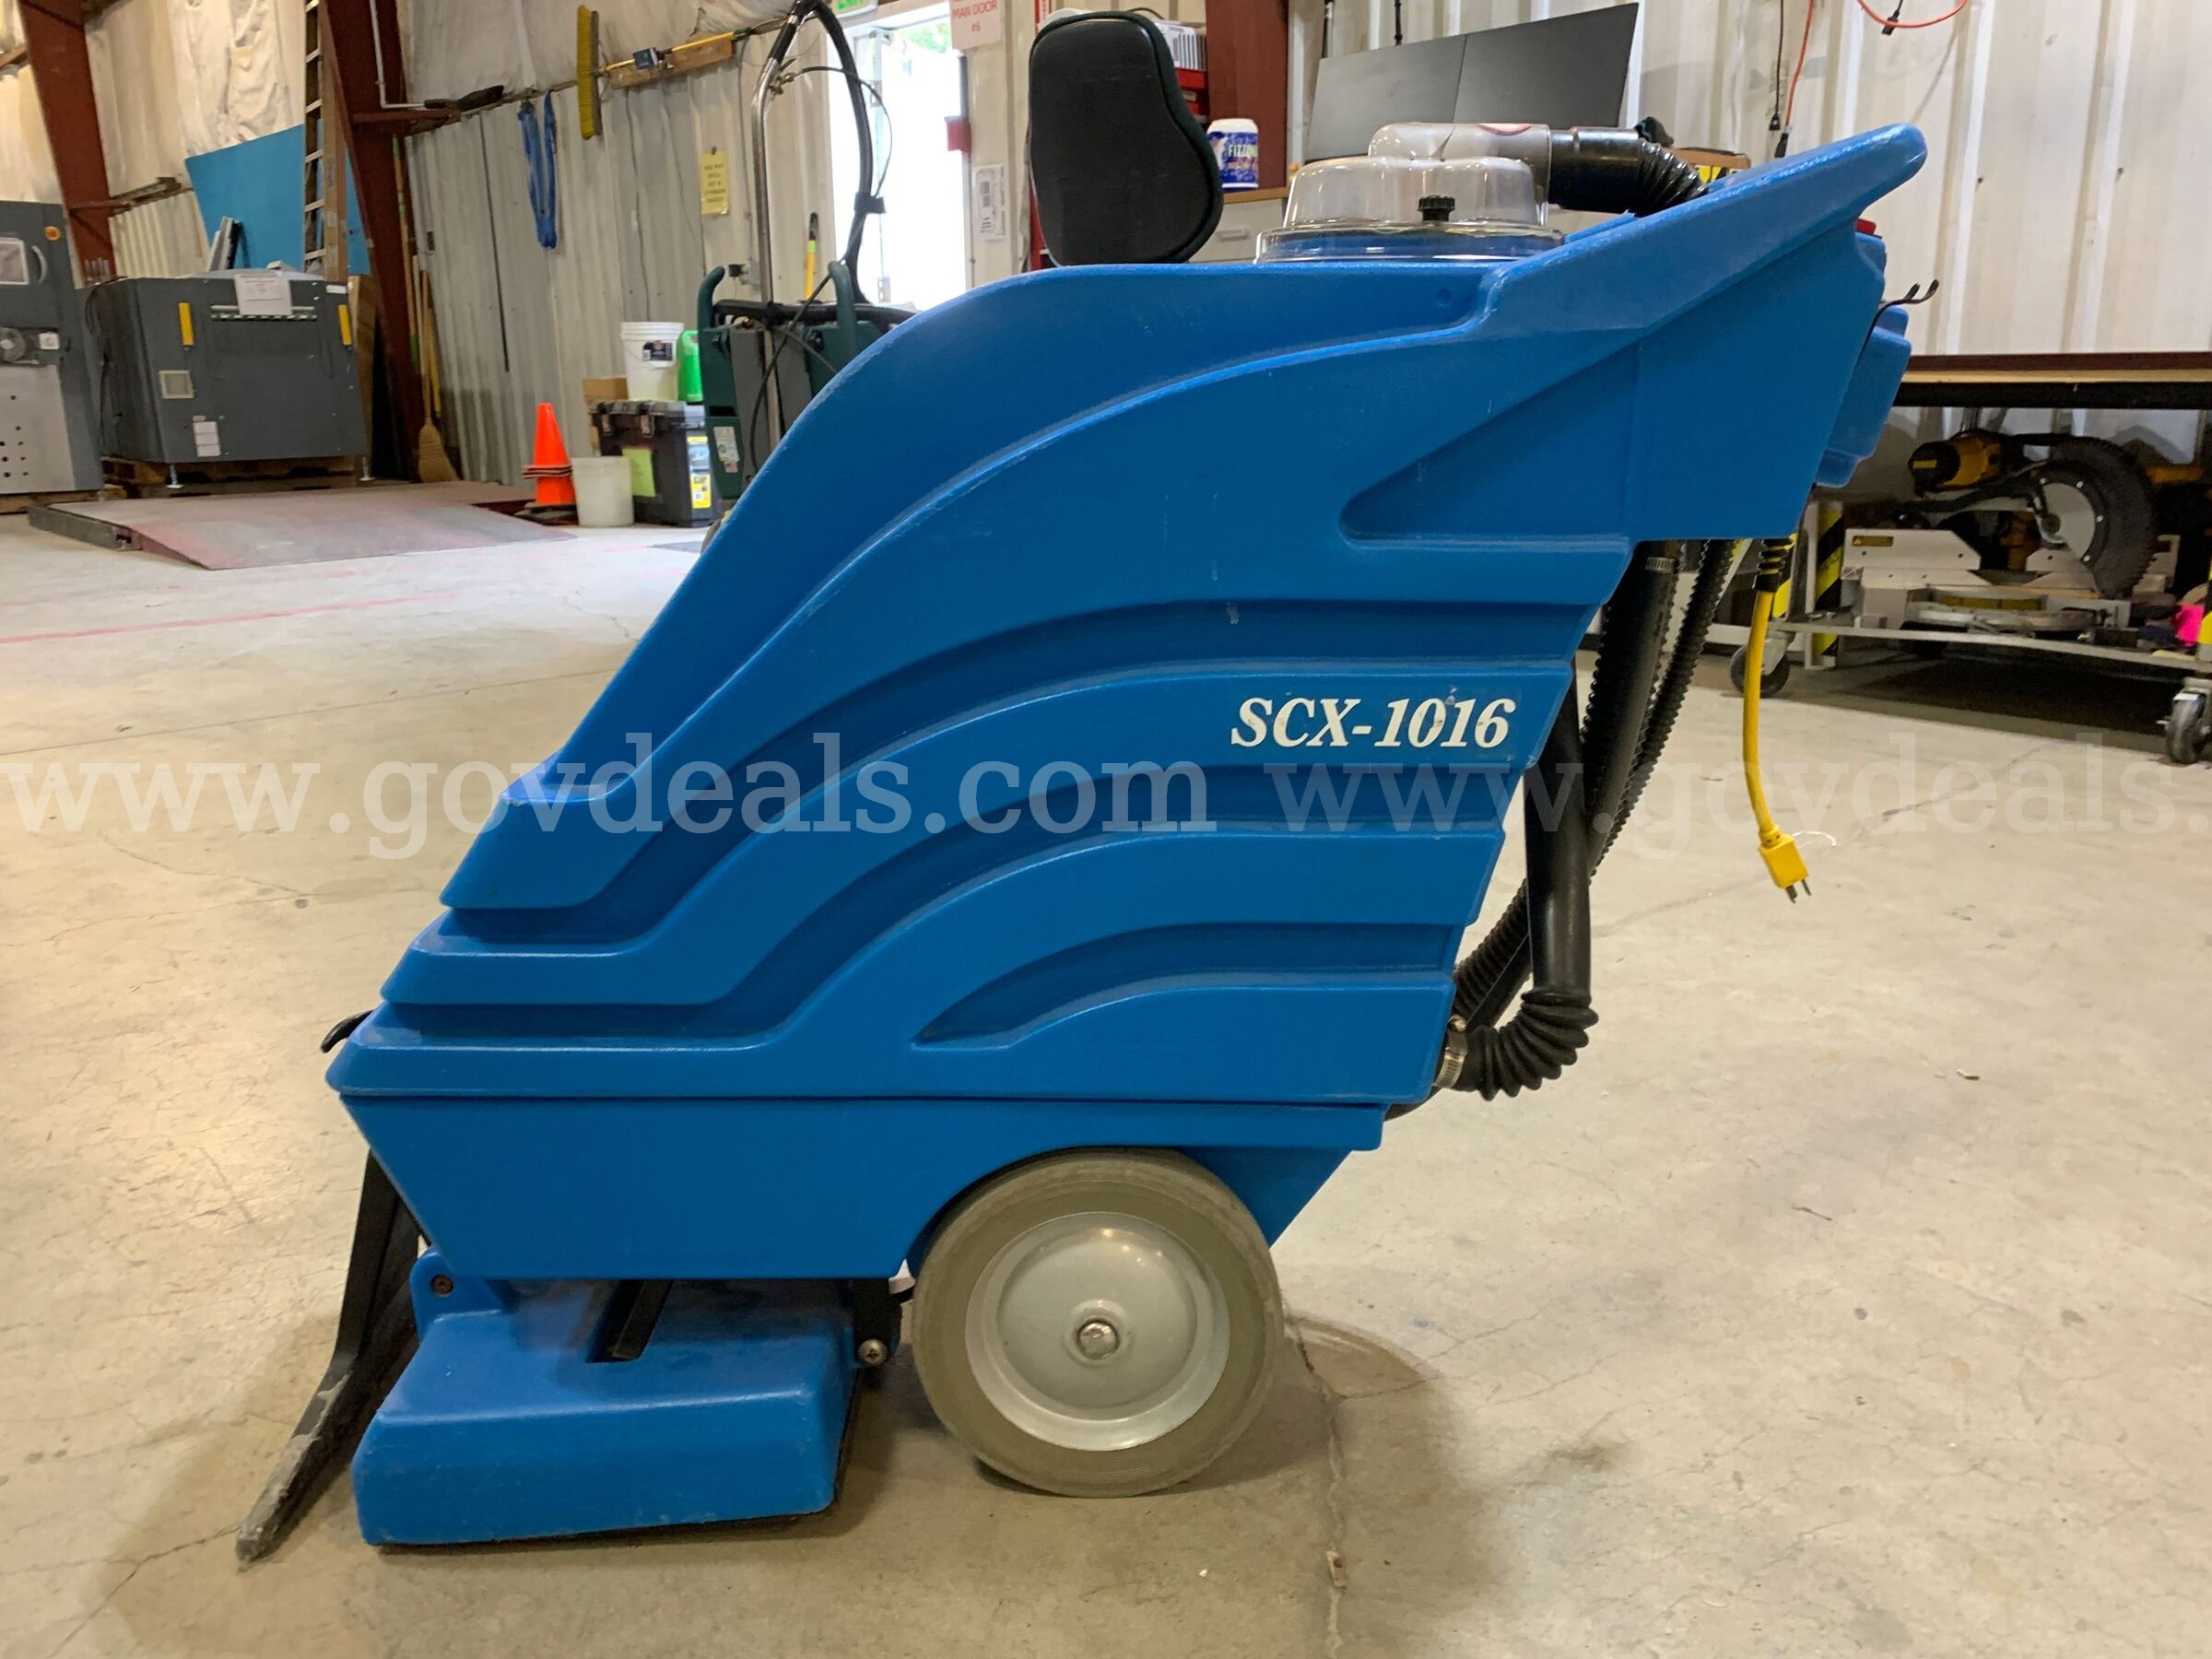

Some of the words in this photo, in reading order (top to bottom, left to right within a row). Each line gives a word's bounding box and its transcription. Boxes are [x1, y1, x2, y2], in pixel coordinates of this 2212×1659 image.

[952, 6, 971, 18] MAN
[972, 0, 998, 15] DOOR
[1230, 698, 1516, 748] SCX-1016
